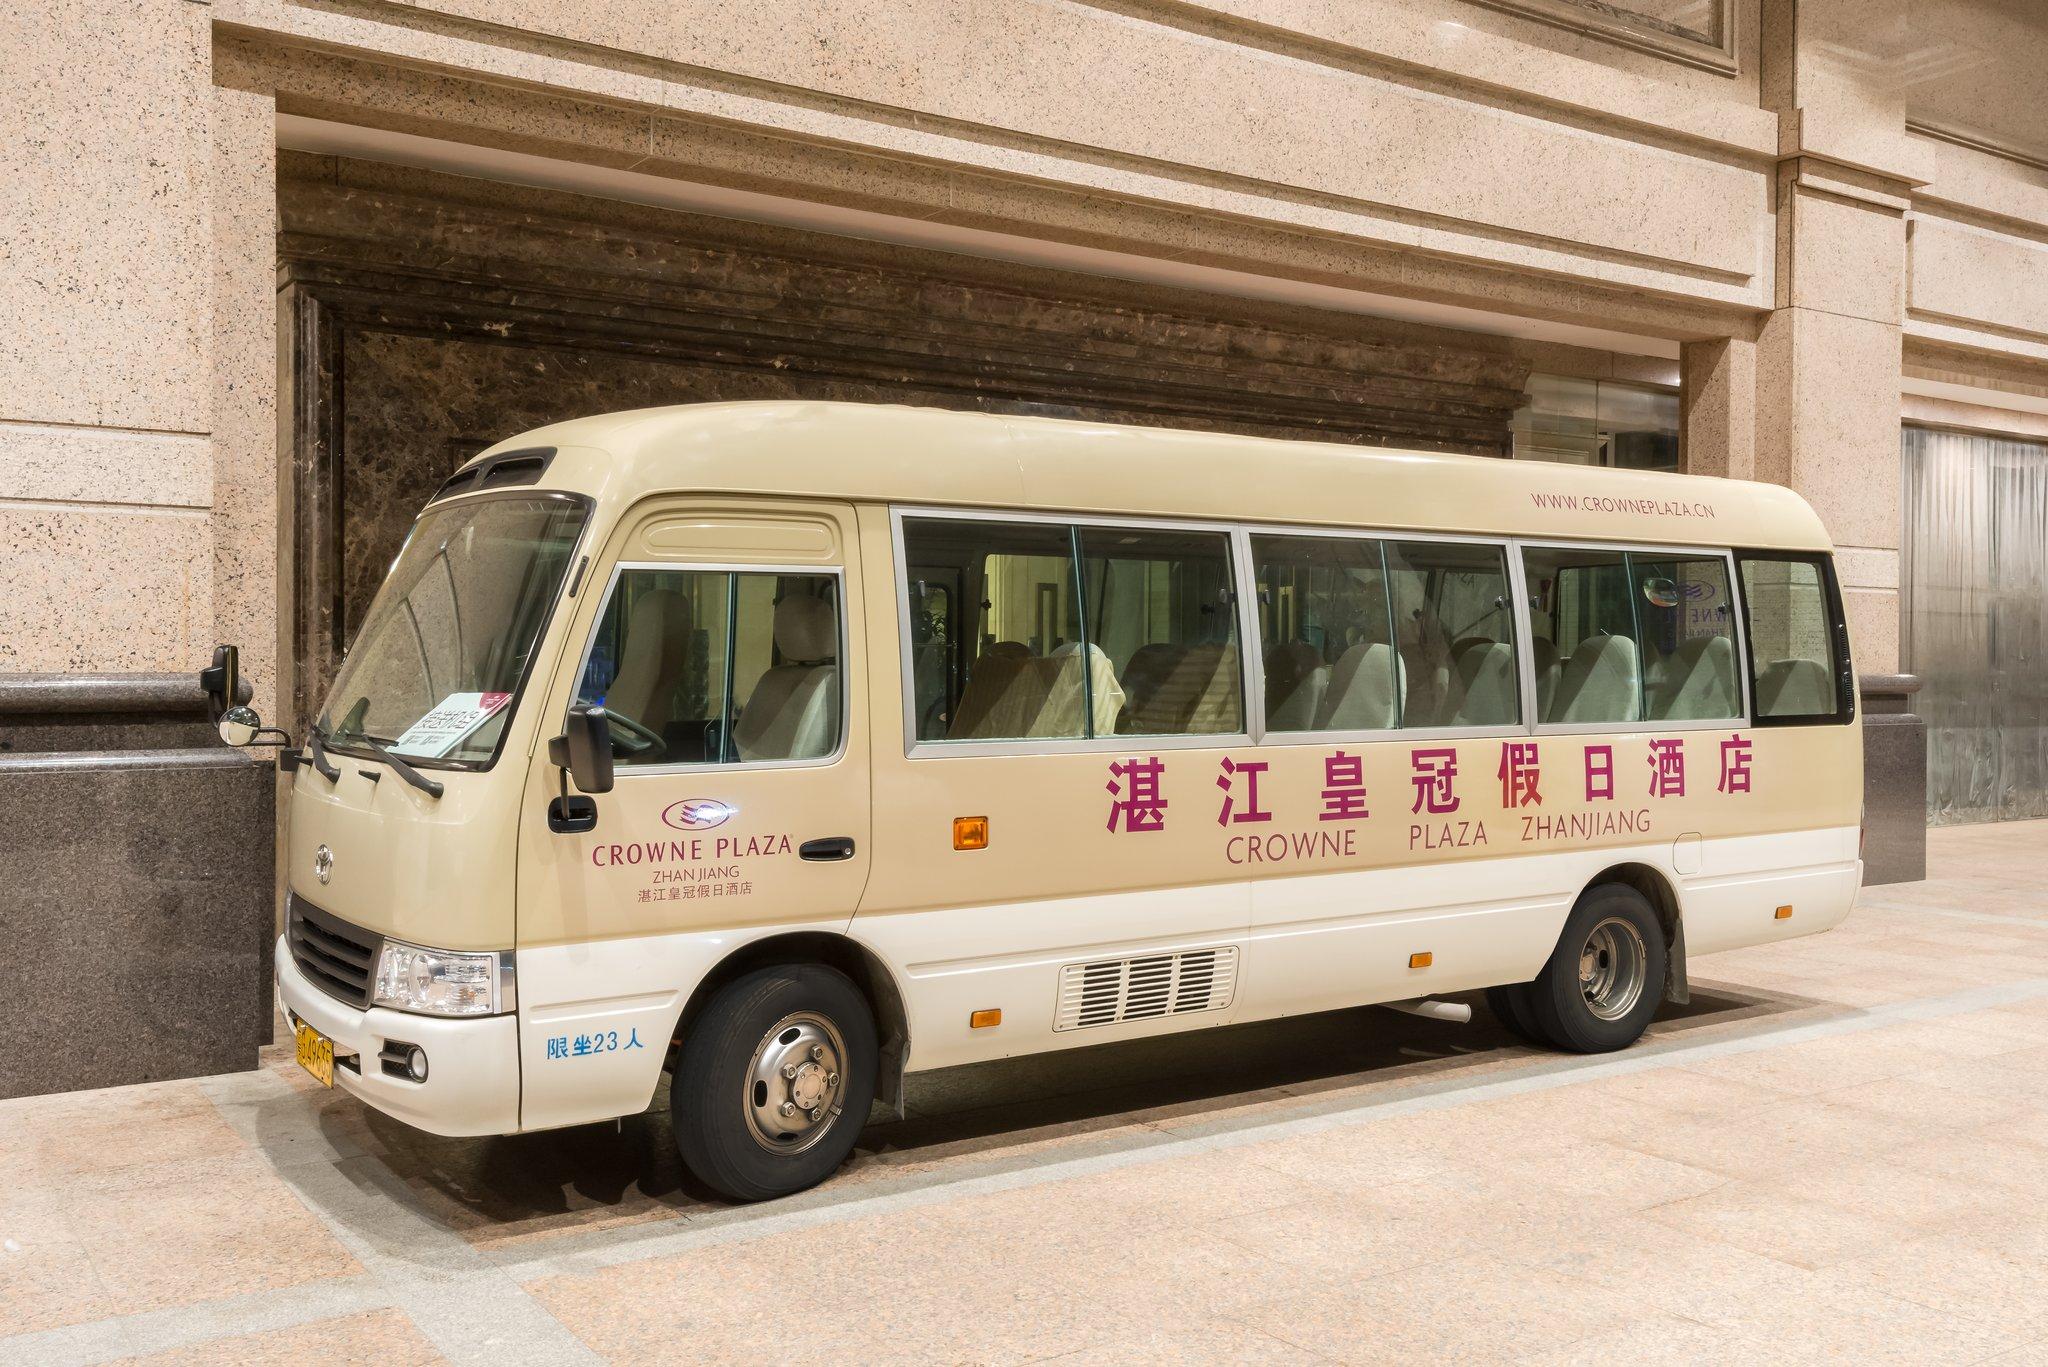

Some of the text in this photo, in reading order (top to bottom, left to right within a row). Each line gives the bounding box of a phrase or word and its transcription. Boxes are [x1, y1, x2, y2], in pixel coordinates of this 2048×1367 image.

[1530, 492, 1715, 519] WWW.CROWNEPLAZA.CN
[1105, 733, 1754, 834] 湛江皇冠假日酒店
[592, 834, 792, 867] CROWNE PLAZA
[1226, 808, 1651, 865] CROWNE PLAZA ZHANJIANG
[652, 865, 740, 884] ZHANJIANG
[637, 880, 753, 903] 湛江皇冠假日酒店
